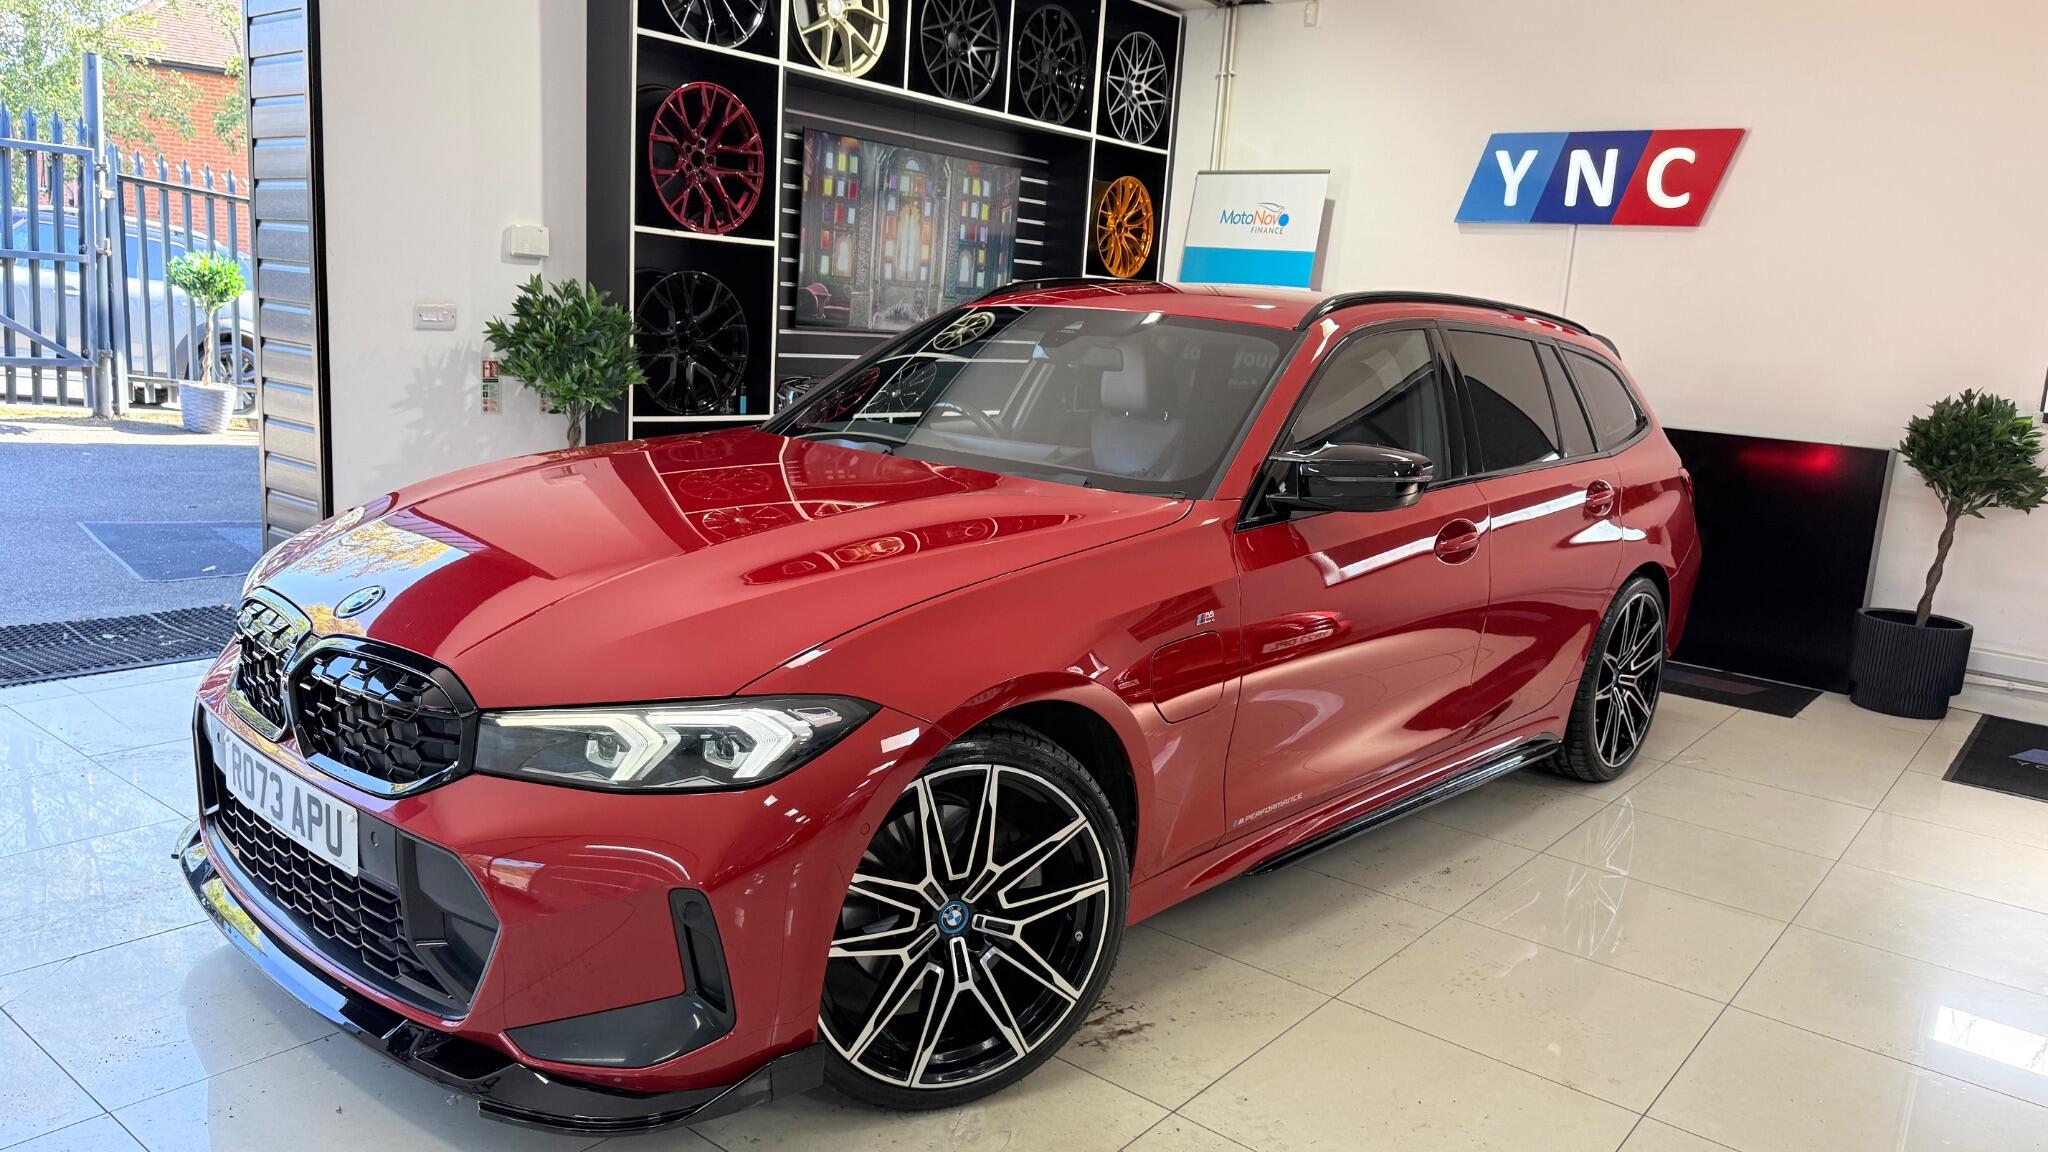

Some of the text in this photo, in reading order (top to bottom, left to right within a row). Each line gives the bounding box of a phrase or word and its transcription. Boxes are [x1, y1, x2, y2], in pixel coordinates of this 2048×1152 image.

[1495, 147, 1696, 209] YNC
[1220, 209, 1290, 227] MotoNovo
[1250, 226, 1284, 235] FINANCE
[231, 741, 343, 858] RO73 APU
[1244, 792, 1303, 823] PERFORMANCE
